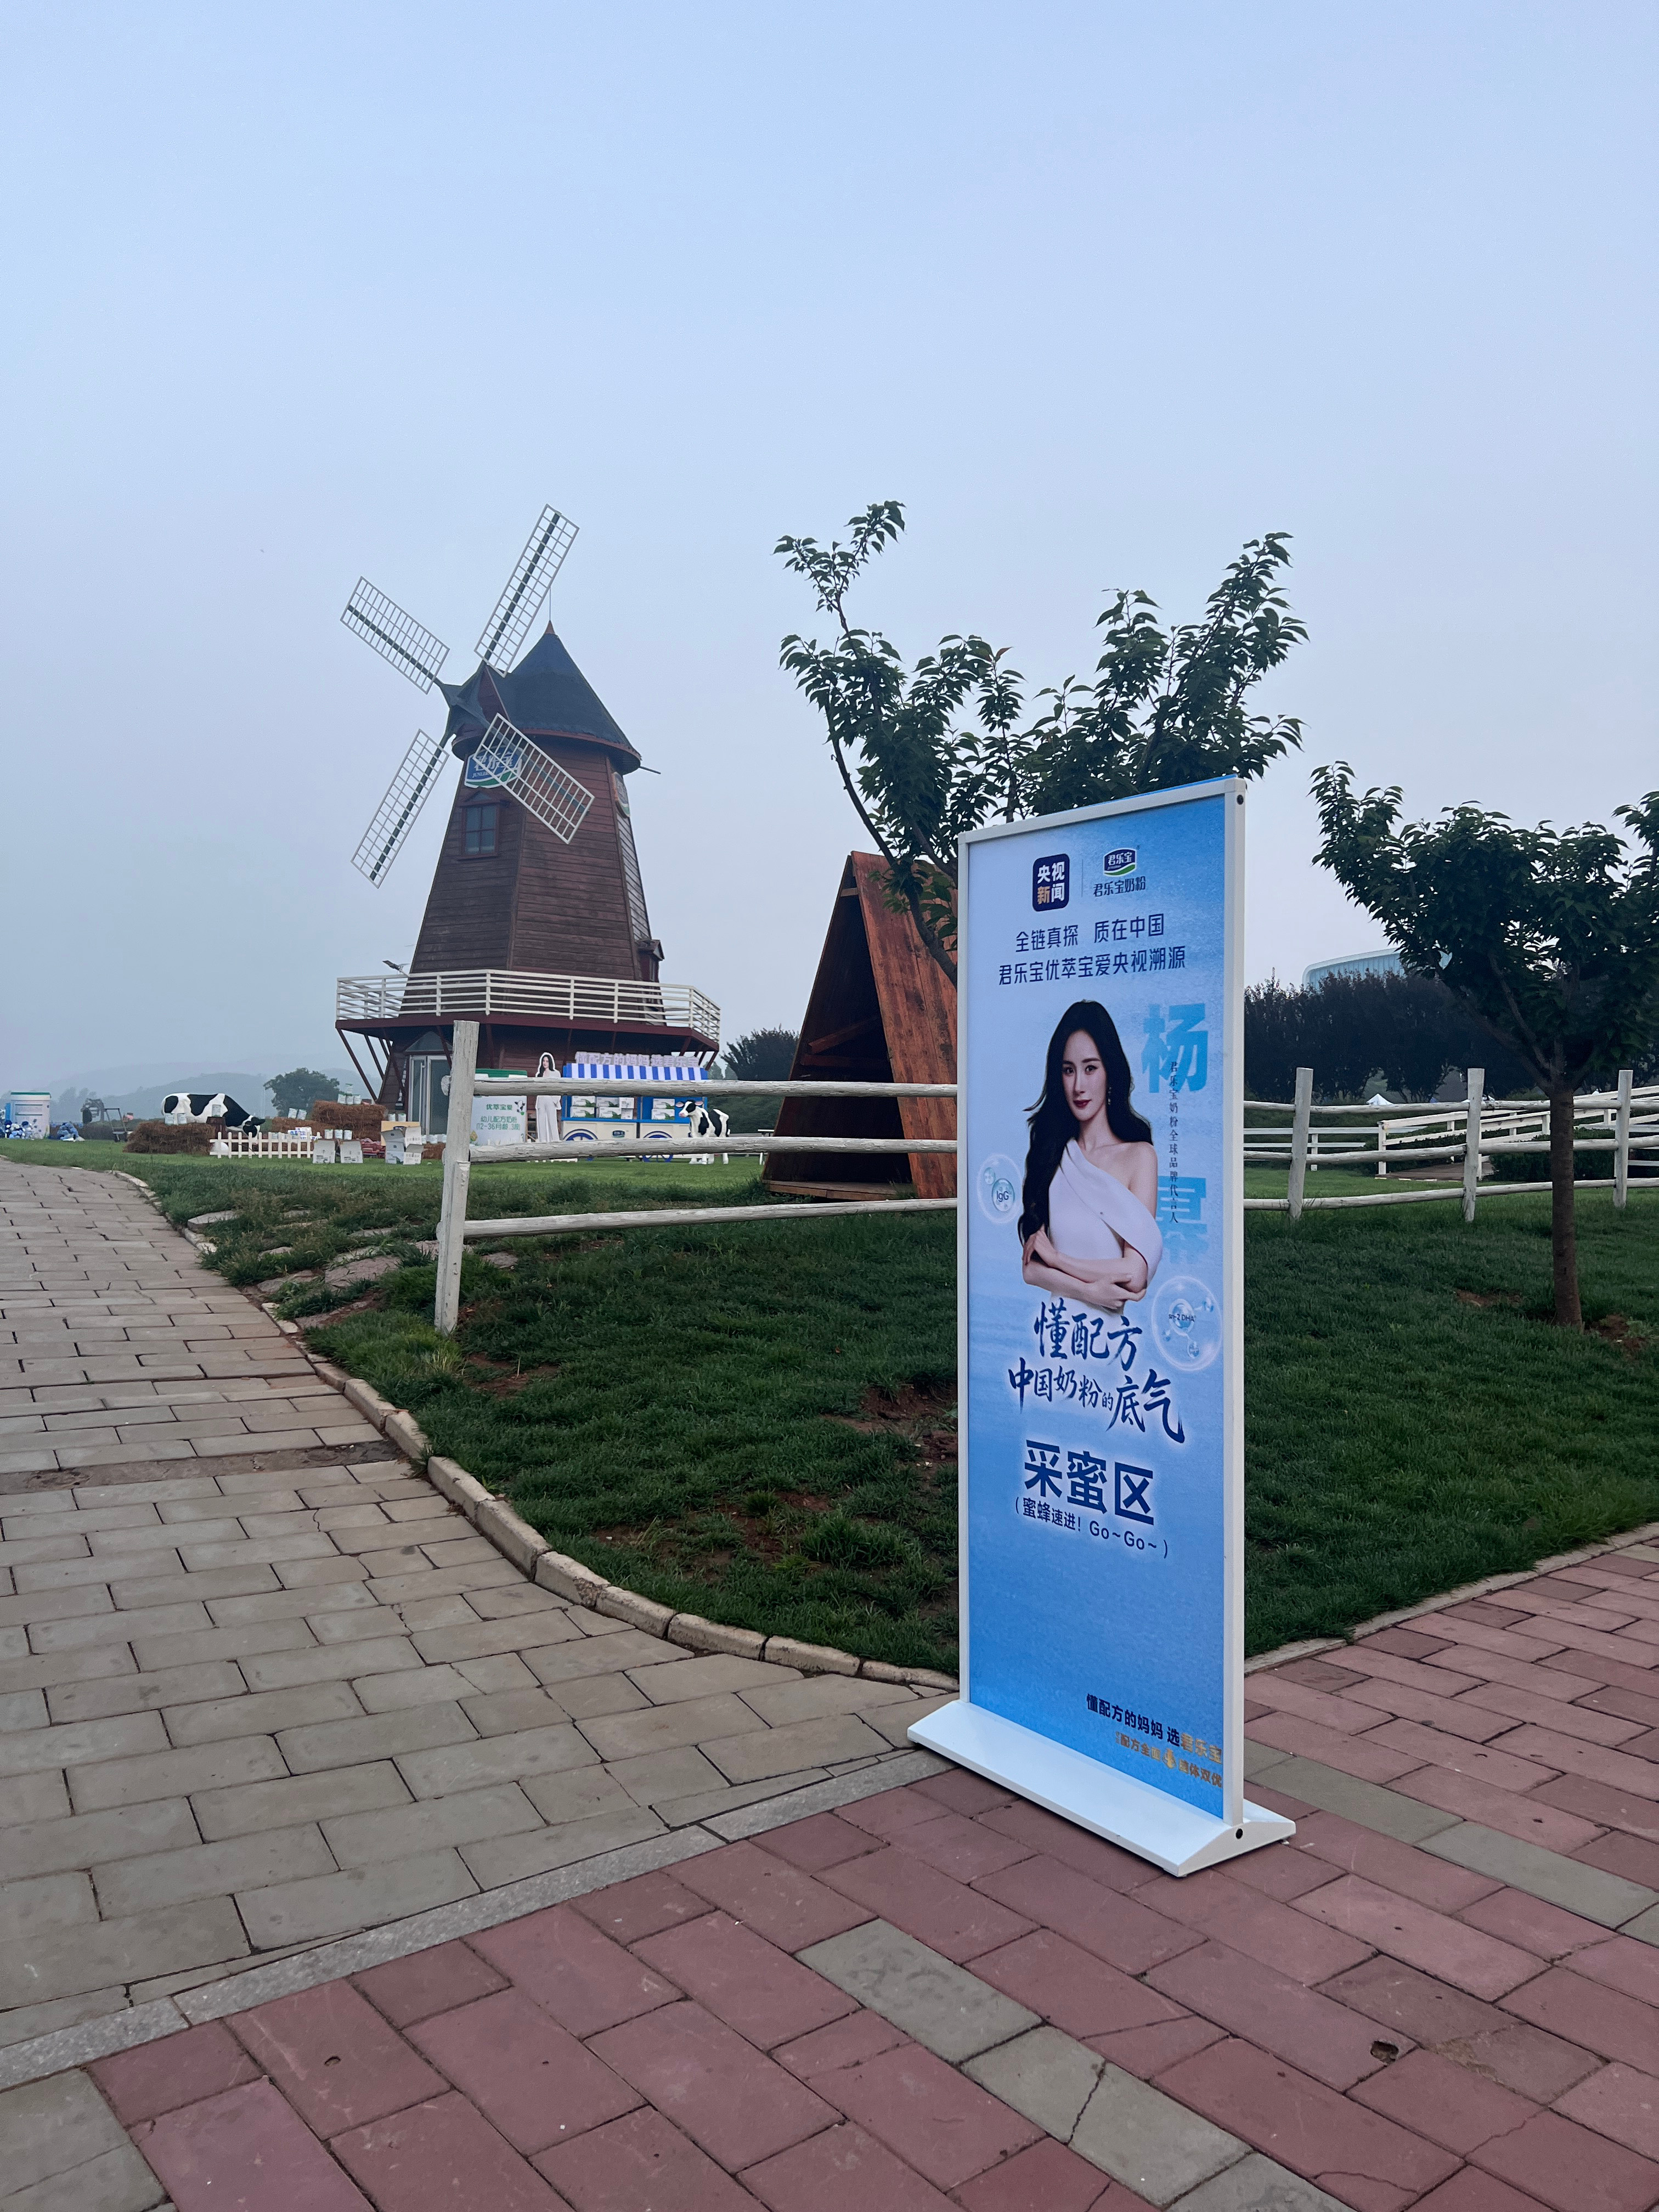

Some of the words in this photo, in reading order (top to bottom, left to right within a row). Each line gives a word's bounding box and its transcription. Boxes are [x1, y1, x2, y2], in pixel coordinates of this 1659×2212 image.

[1037, 861, 1065, 884] 央视
[1107, 851, 1132, 866] 君乐宝
[1037, 882, 1064, 905] 新闻
[1093, 876, 1146, 897] 君乐宝奶粉
[1015, 925, 1078, 952] 全链真探
[1094, 913, 1164, 943] 质在中国
[998, 946, 1186, 985] 君乐宝优萃宝爱央视溯源
[1169, 1061, 1179, 1223] 君乐宝奶粉全球品牌代言人
[996, 1190, 1009, 1202] IgG
[1034, 1297, 1142, 1371] 懂配方
[1008, 1357, 1186, 1443] 中国奶粉的底气
[1024, 1440, 1154, 1525] 采蜜区
[1086, 1693, 1163, 1740] 懂配方的妈妈
